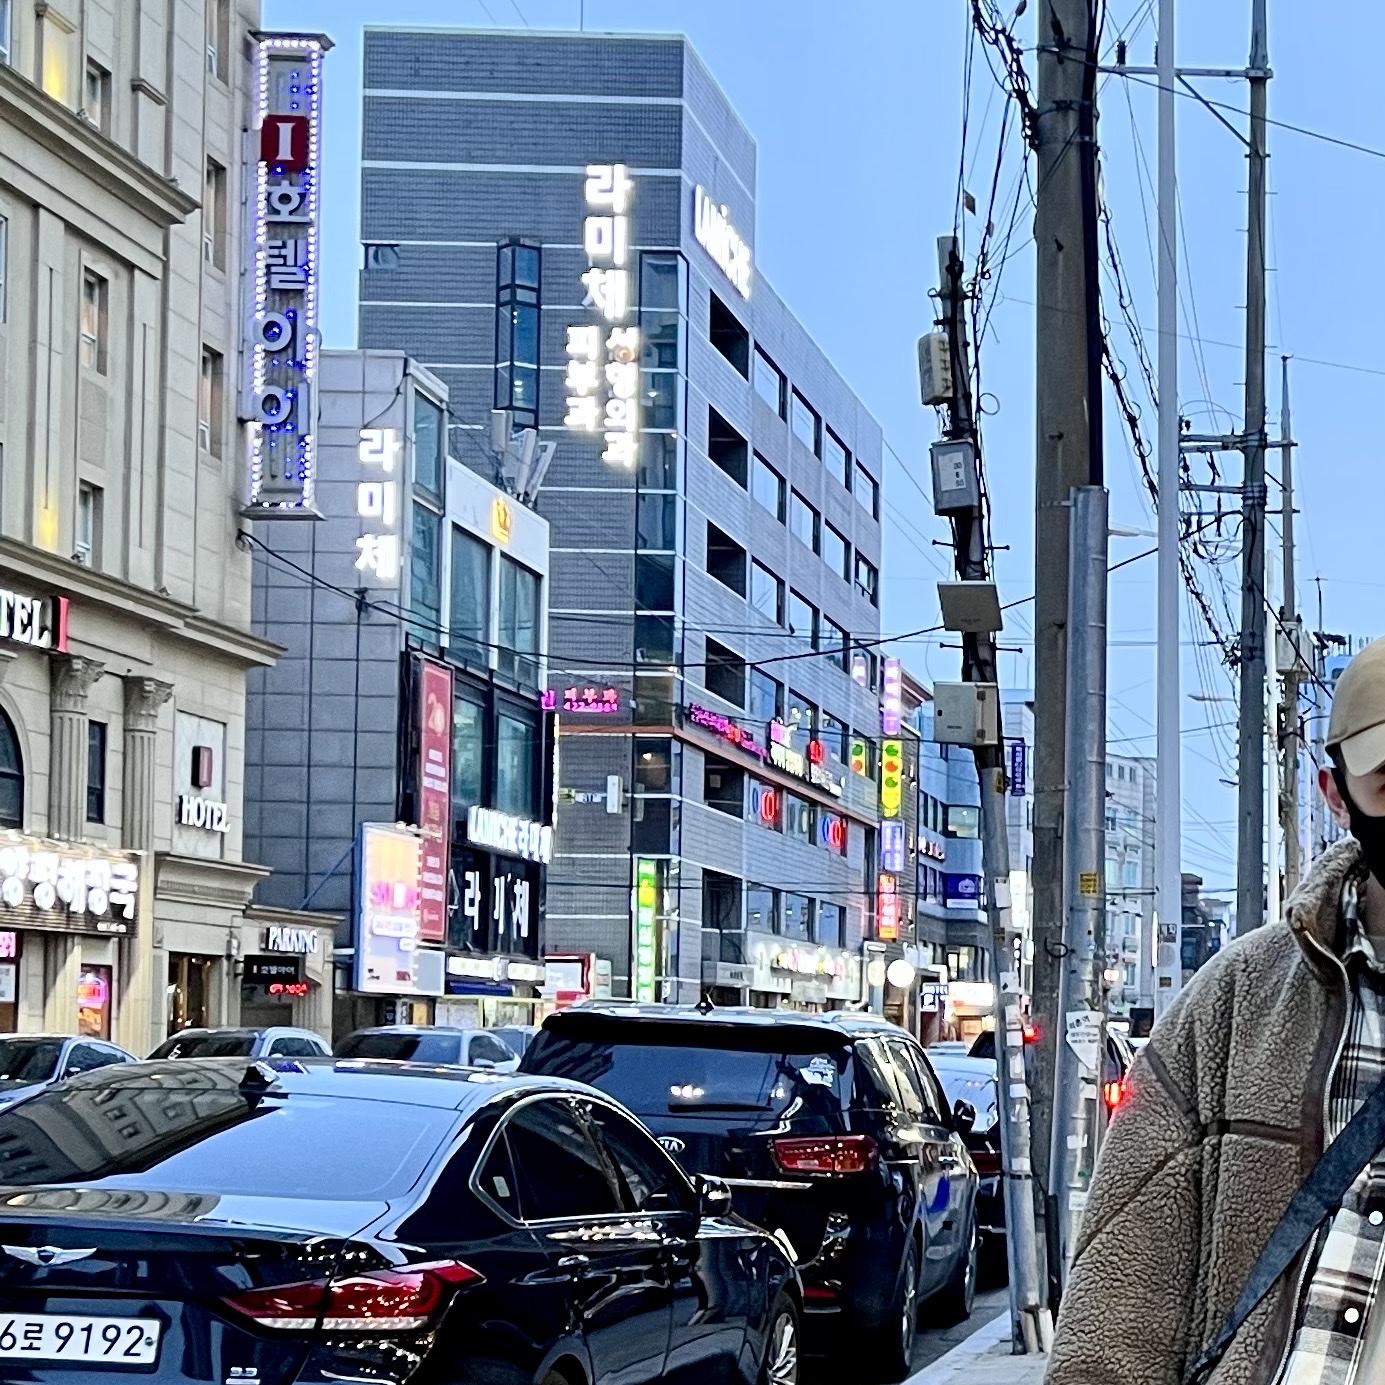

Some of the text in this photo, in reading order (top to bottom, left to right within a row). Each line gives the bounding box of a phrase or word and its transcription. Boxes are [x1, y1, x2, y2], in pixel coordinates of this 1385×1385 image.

[581, 163, 634, 319] 라미체
[355, 428, 402, 579] 라미체
[182, 795, 231, 832] HOTEL
[268, 926, 318, 953] PARKING
[54, 1322, 144, 1357] 9192
